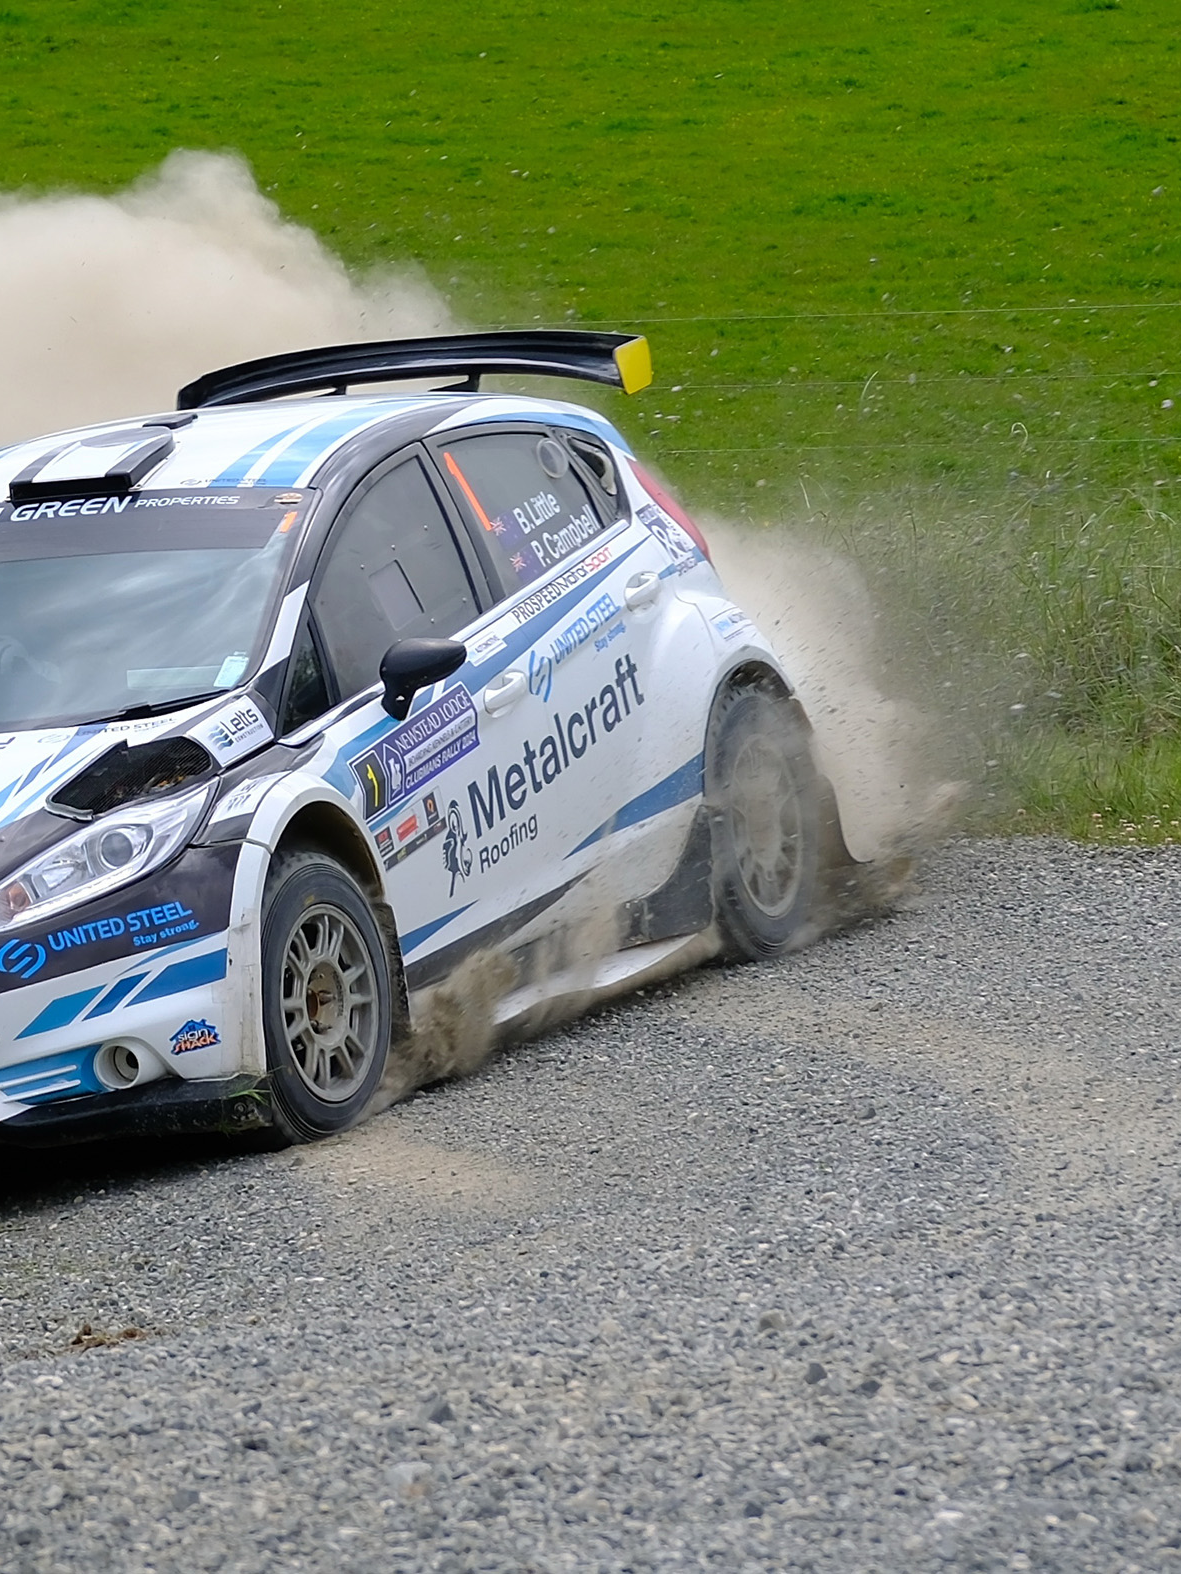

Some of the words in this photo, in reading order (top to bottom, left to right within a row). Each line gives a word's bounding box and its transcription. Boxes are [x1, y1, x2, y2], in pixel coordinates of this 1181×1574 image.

[10, 495, 133, 522] GREEN
[134, 495, 241, 508] PROPERTIES
[279, 511, 298, 533] 1
[531, 540, 552, 568] P.
[542, 504, 601, 559] Campbell
[549, 617, 591, 664] UNITED
[585, 592, 622, 633] STEEL
[133, 718, 177, 729] STEEL
[220, 708, 259, 736] Letts
[394, 712, 441, 753] NEWSTEAD
[439, 690, 471, 721] LODGE
[406, 757, 442, 789] CLUBMANS
[440, 741, 461, 765] RALLY
[467, 653, 645, 839] Metalcraft
[366, 763, 379, 807] 1
[479, 814, 538, 873] Roofing
[48, 917, 125, 951] UNITED
[126, 900, 194, 932] STEEL
[132, 932, 158, 947] Stay
[159, 918, 200, 940] strong.
[174, 1033, 218, 1053] SHACK
[178, 1028, 209, 1042] sign
